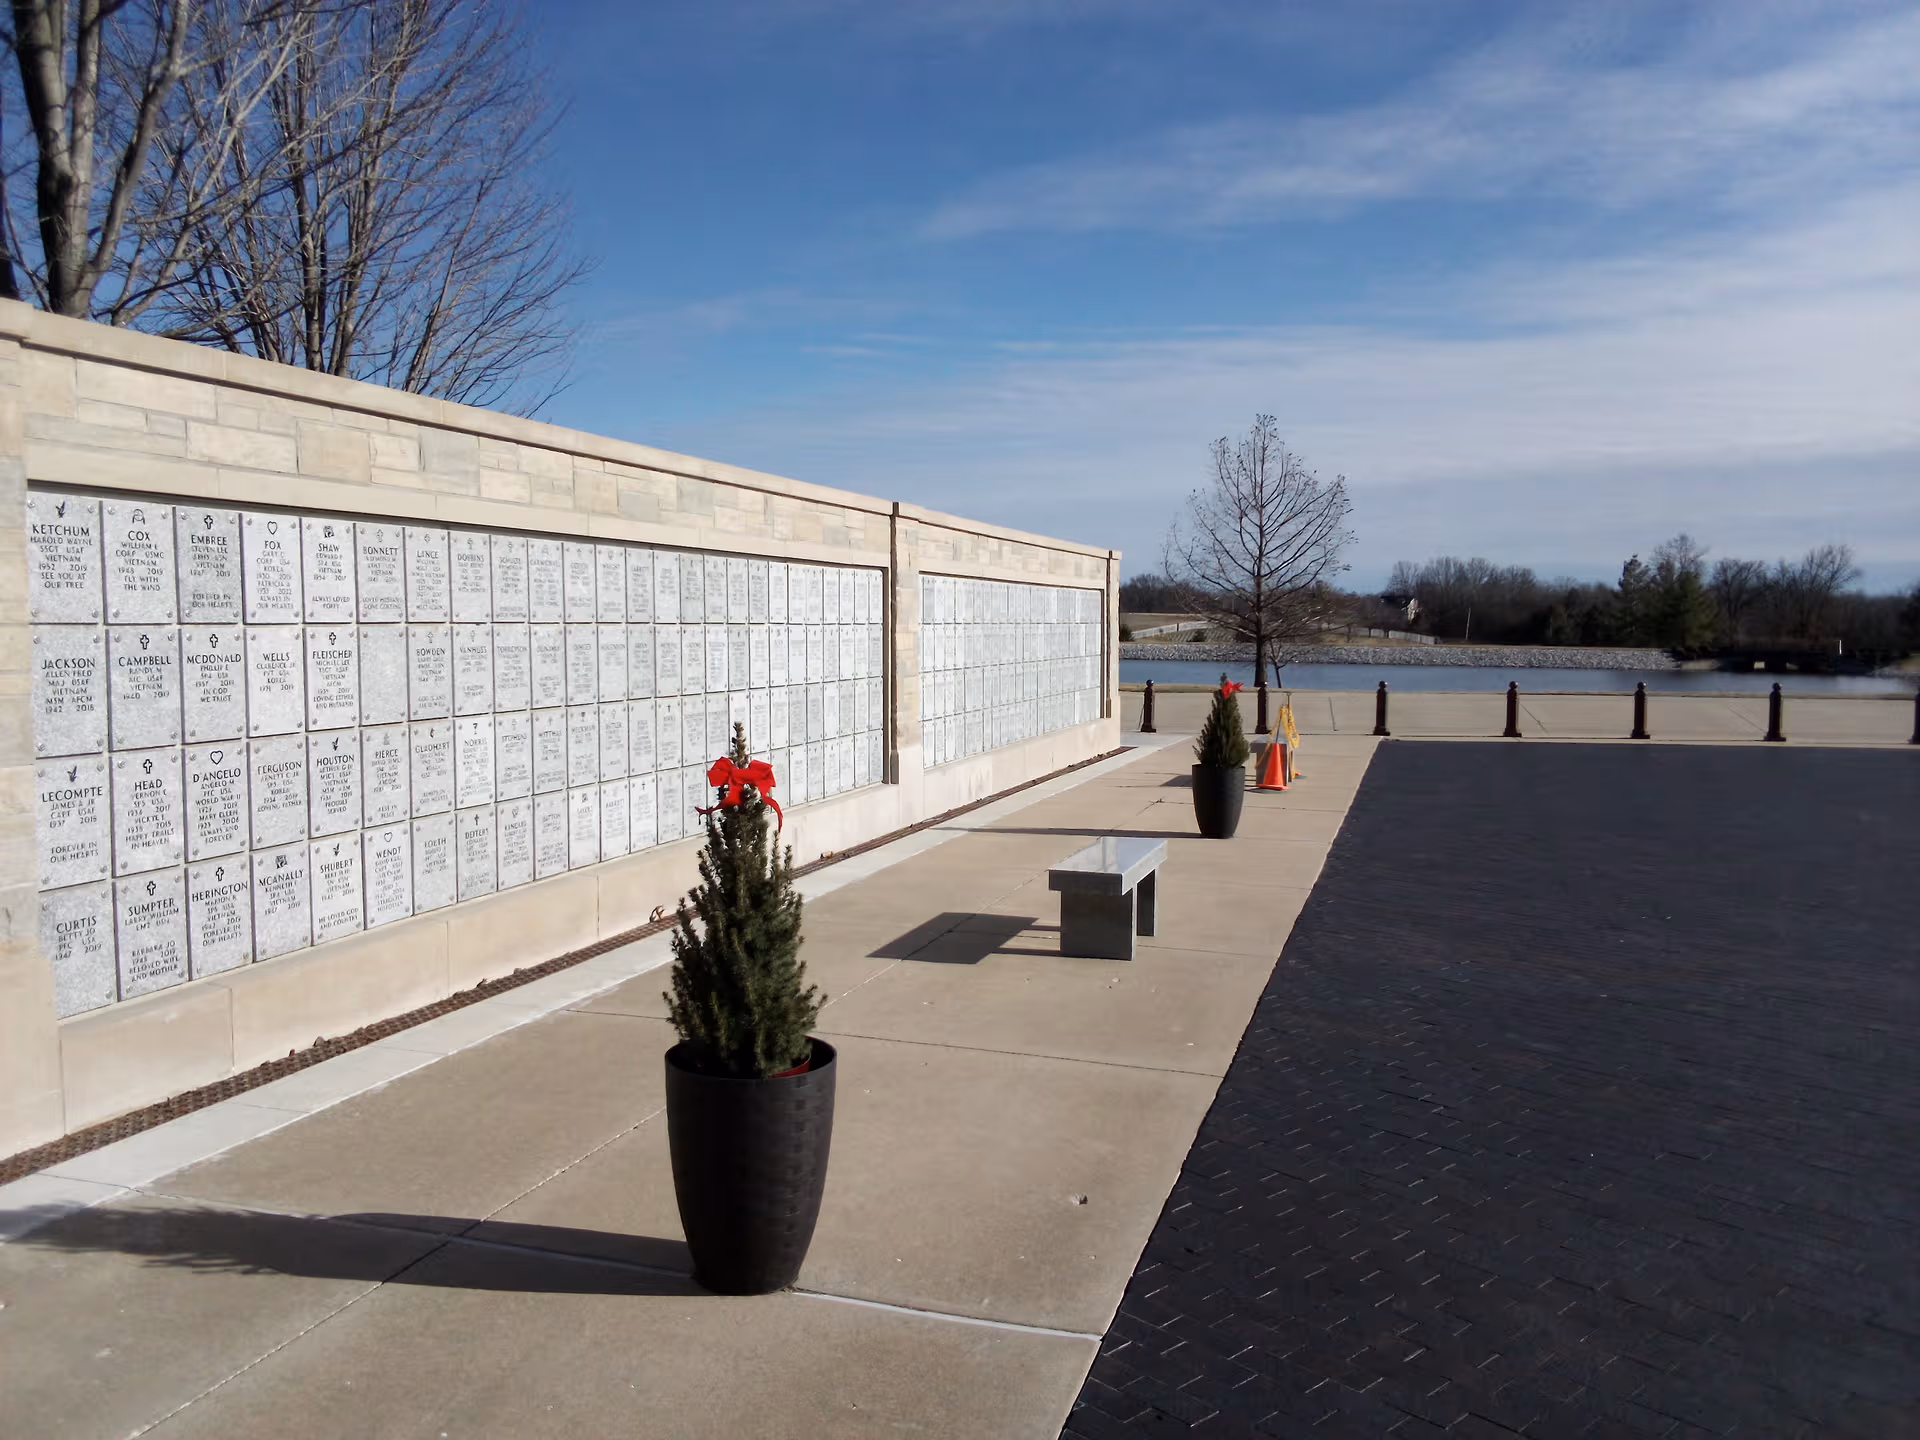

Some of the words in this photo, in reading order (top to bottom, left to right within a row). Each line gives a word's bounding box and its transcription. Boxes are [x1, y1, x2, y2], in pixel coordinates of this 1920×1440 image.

[32, 524, 90, 536] KETCHUM
[128, 531, 150, 541] COX
[191, 535, 227, 545] EMBREE
[265, 540, 281, 549] FOX
[318, 543, 340, 551] SHAW
[125, 558, 157, 566] VIETNAM
[187, 654, 241, 664] MCDONALD
[263, 653, 290, 662] WELLS
[312, 650, 352, 659] FLEISCHER
[42, 658, 95, 669] JACKSON
[118, 656, 171, 666] CAMPBELL
[317, 755, 354, 766] HOUSTON
[258, 762, 302, 774] FERGUSON
[134, 779, 162, 790] HEAD
[42, 786, 102, 803] LECOMPTE
[196, 797, 218, 806] WORLD
[142, 838, 169, 847] HEAVEN
[52, 844, 84, 854] FOREVER
[376, 846, 401, 858] WENDT
[50, 854, 67, 863] OUR
[70, 850, 98, 860] HEARTS
[320, 858, 353, 873] SHUBERT
[259, 869, 304, 886] MCANALLY
[192, 881, 247, 902] HERINGTON
[128, 898, 175, 916] SUMPTER
[149, 908, 179, 920] WILLIAM
[207, 910, 235, 922] VIETNAM
[56, 916, 96, 933] CURTIS
[58, 930, 82, 941] BETTY
[85, 928, 95, 936] JO
[219, 932, 242, 943] HEARTS
[82, 937, 95, 945] USA
